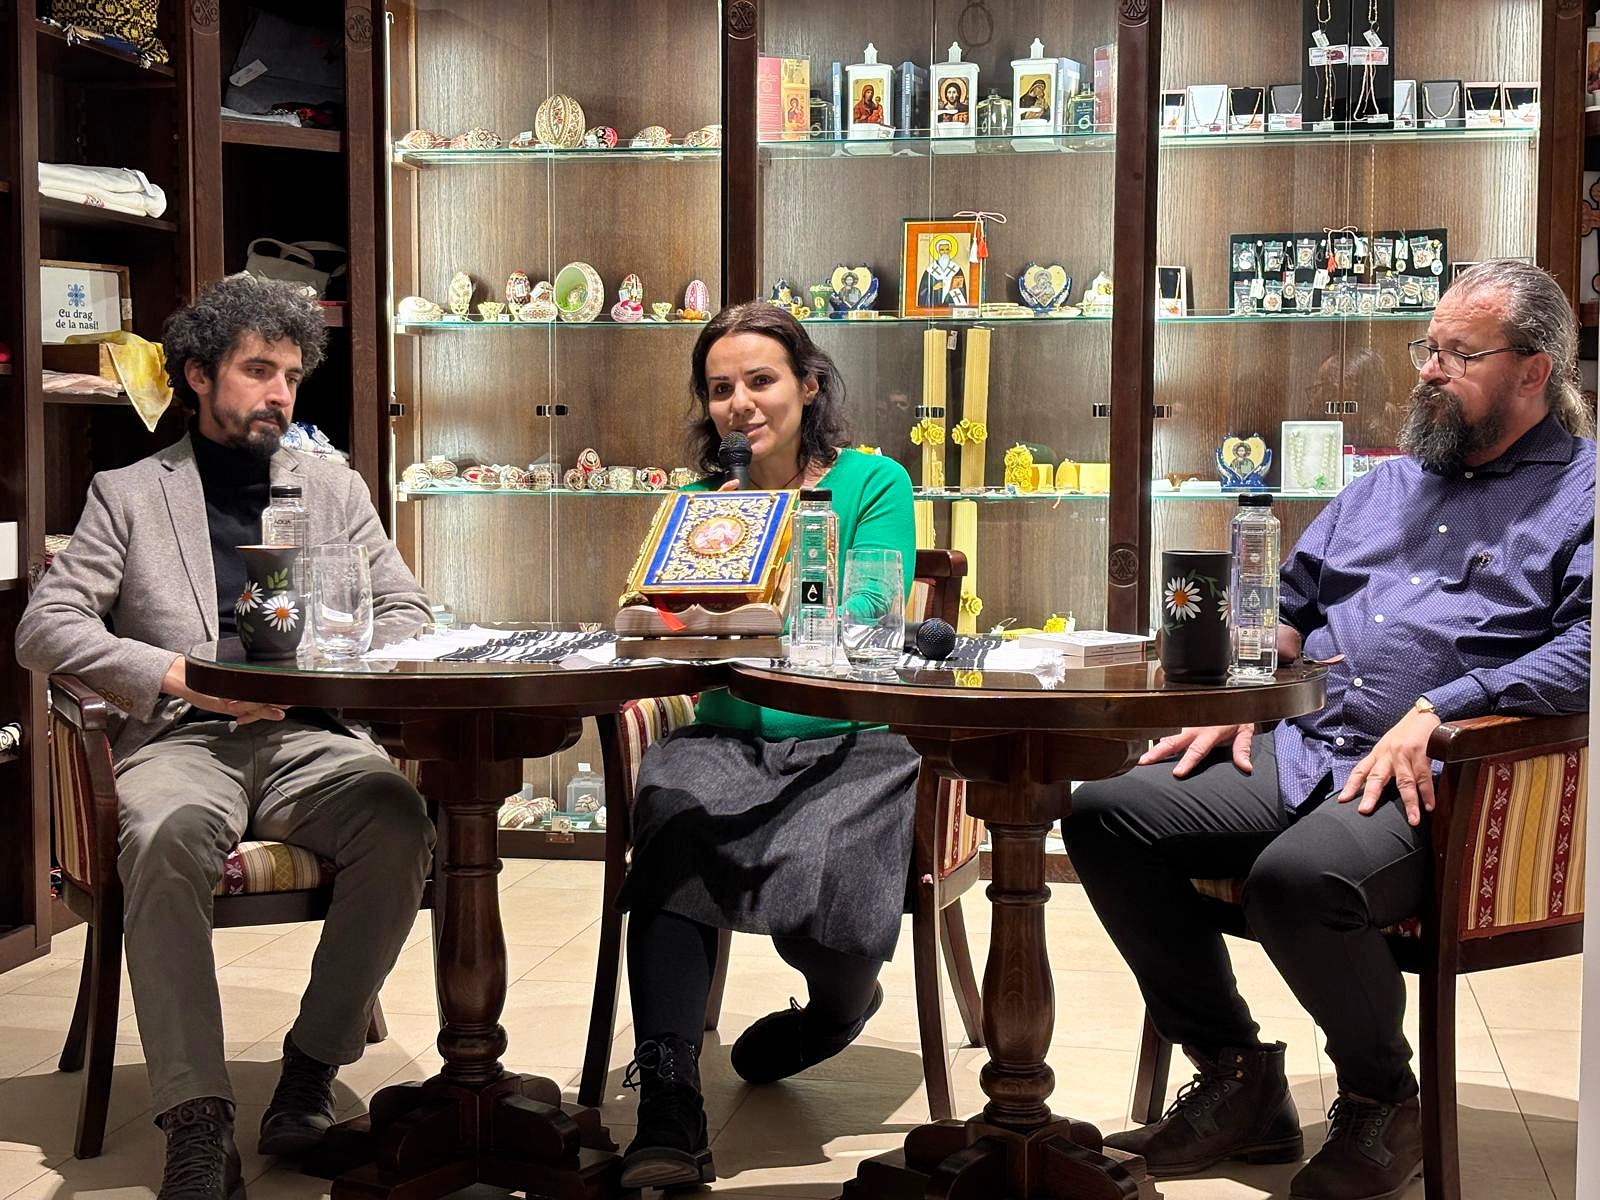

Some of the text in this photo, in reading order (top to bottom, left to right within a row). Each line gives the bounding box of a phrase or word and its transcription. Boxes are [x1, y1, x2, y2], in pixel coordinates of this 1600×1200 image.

[58, 308, 93, 321] Cu drag
[55, 319, 66, 329] de
[68, 320, 77, 329] la
